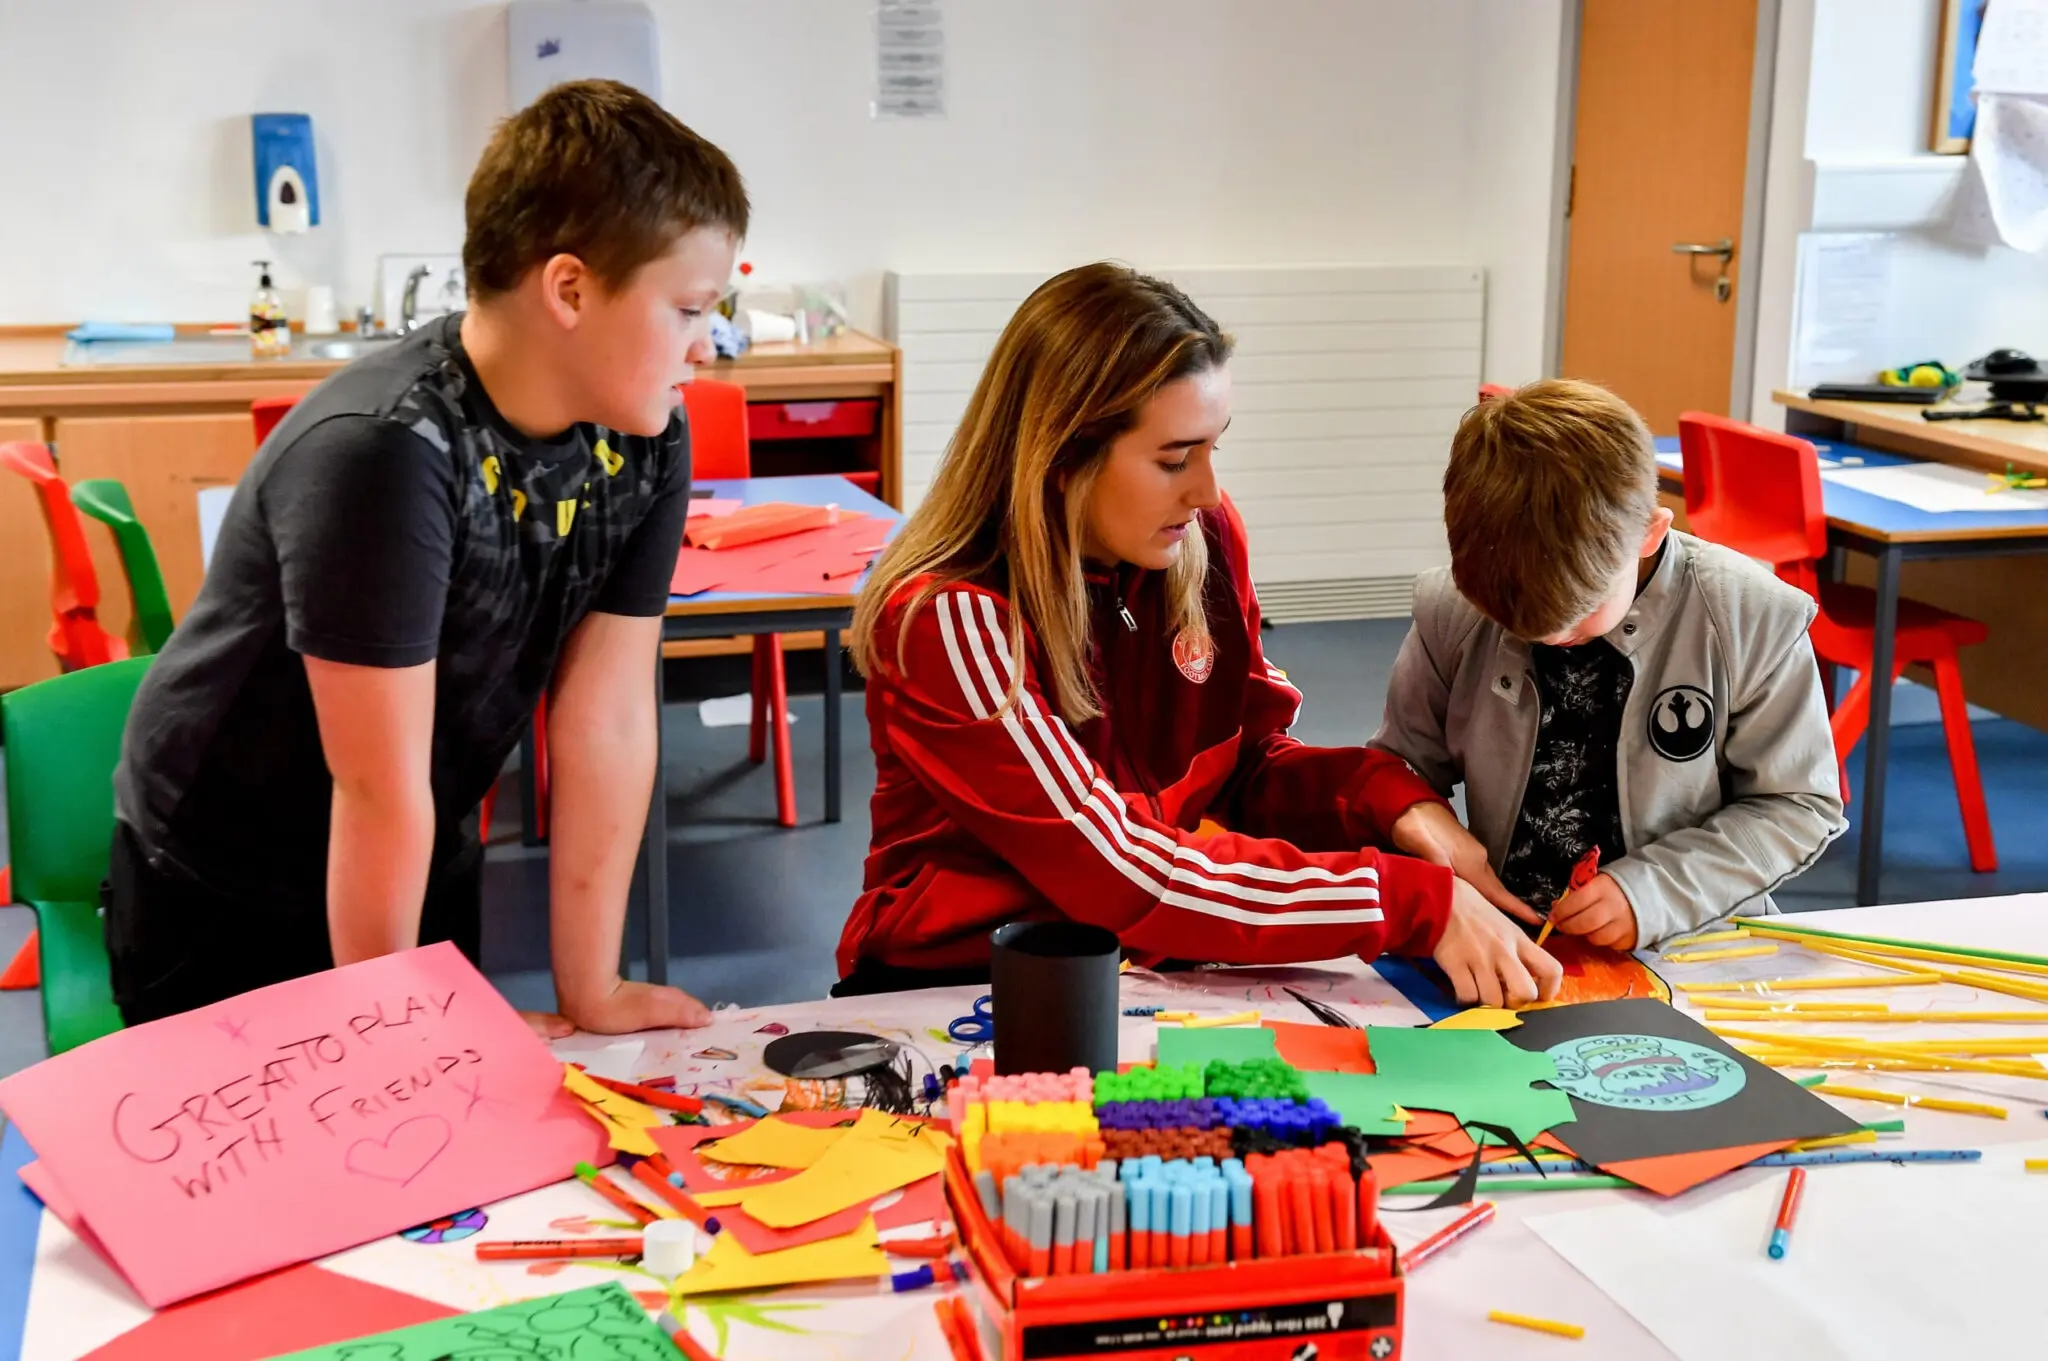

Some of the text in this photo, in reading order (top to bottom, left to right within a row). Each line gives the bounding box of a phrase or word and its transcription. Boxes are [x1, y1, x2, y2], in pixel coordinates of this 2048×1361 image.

[112, 990, 456, 1164] GREAT TO PLAY
[308, 1049, 482, 1138] FRIENDS
